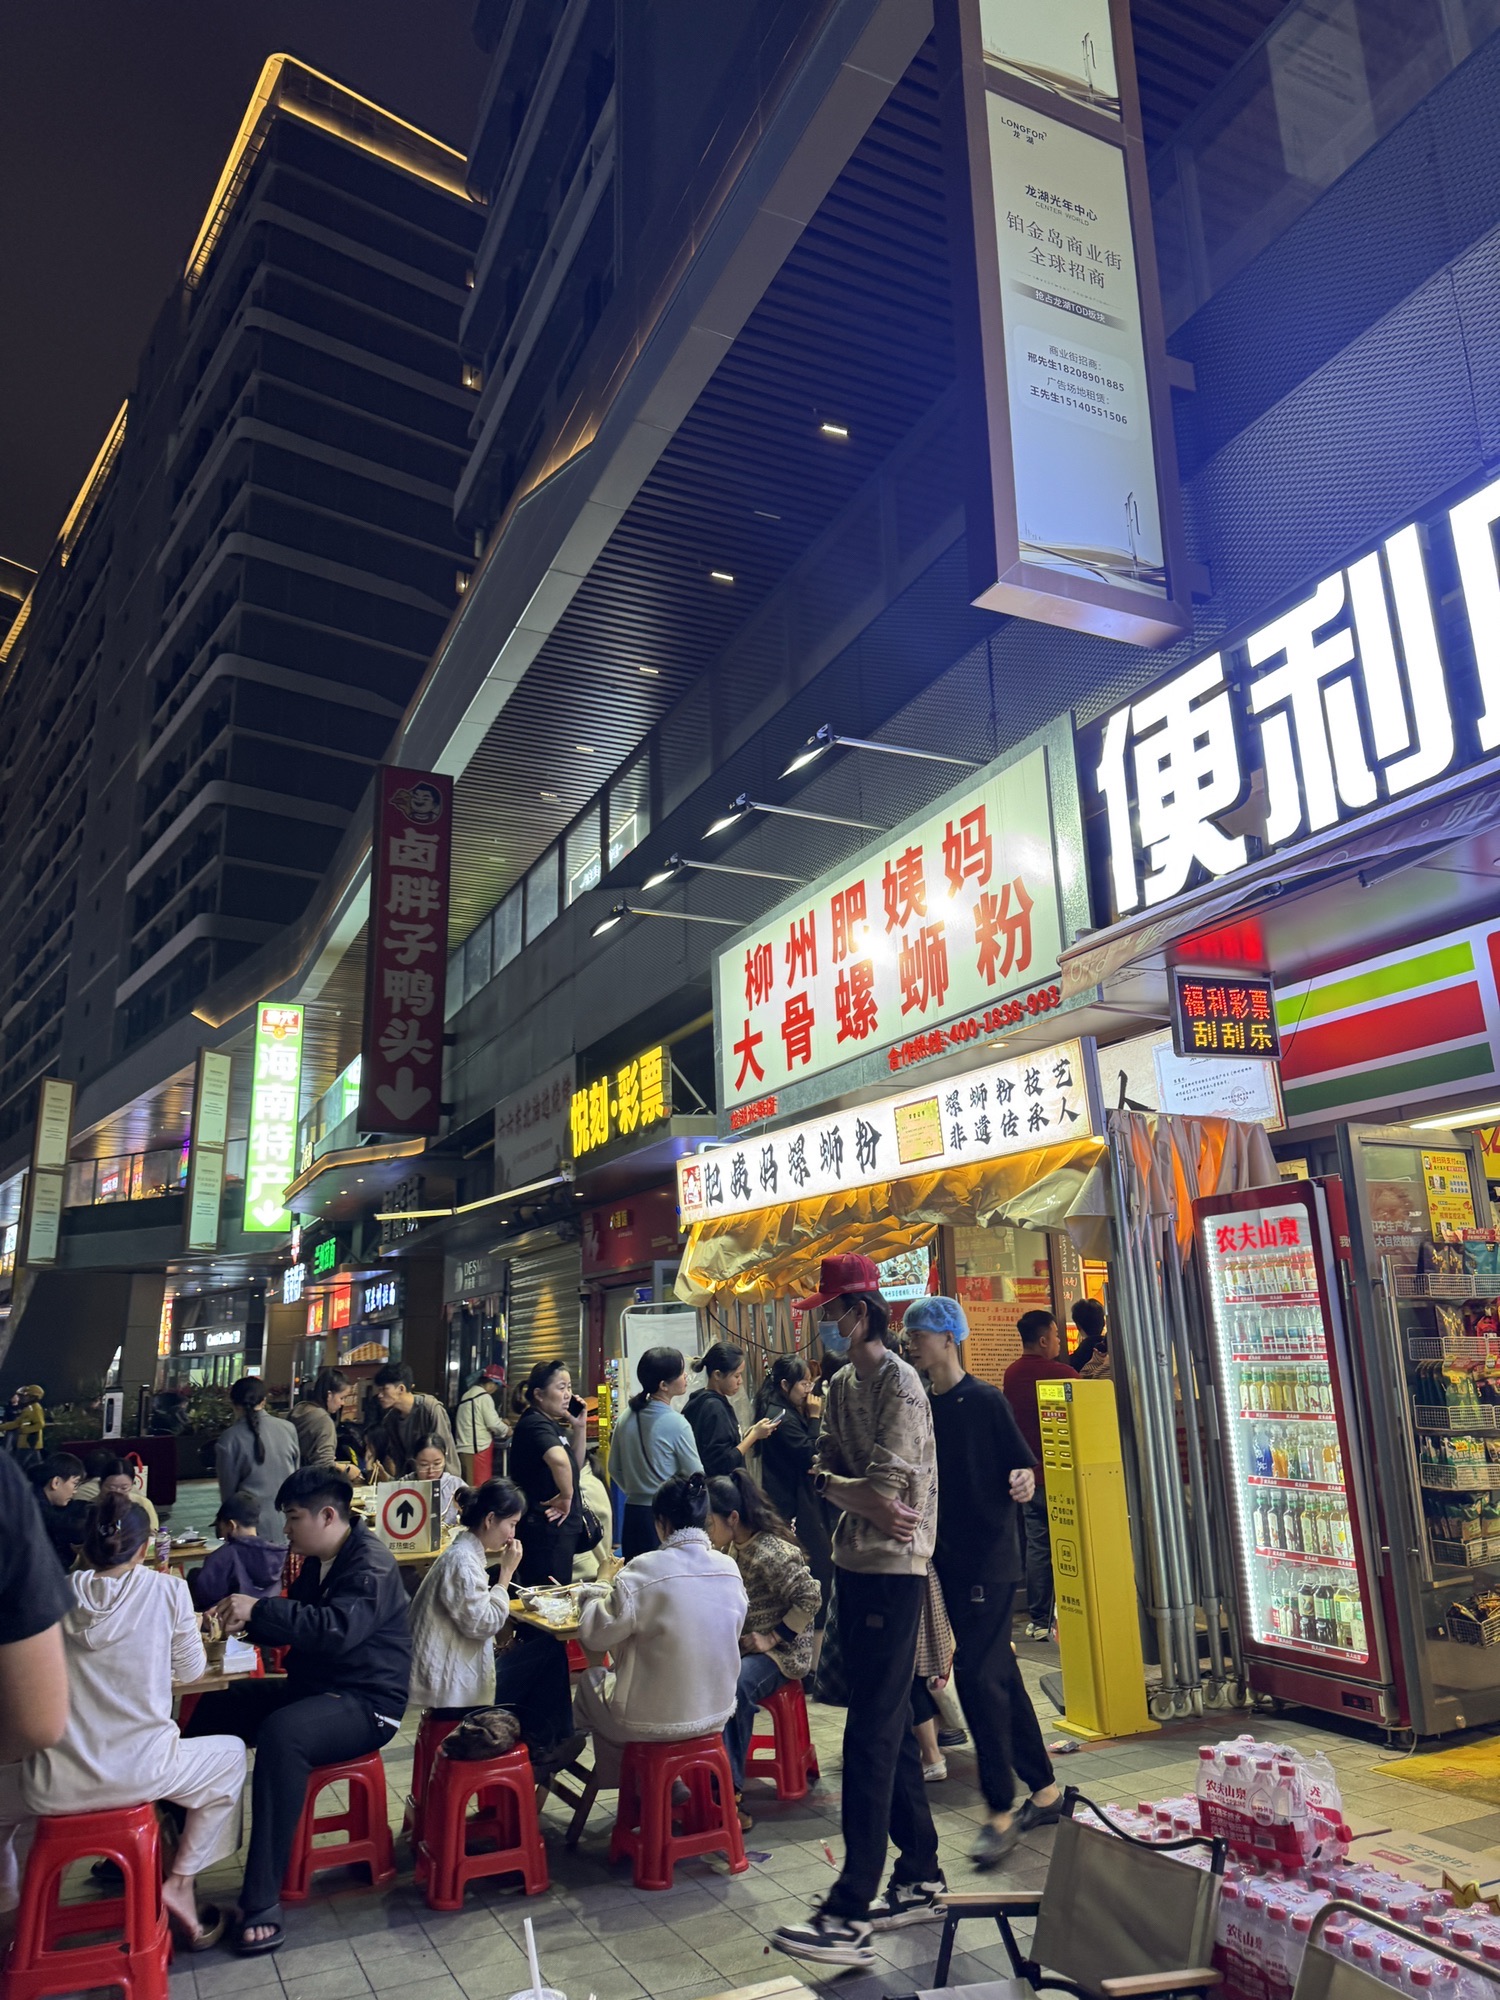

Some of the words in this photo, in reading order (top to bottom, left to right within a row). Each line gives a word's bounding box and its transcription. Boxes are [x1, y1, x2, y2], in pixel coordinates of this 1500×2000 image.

[1025, 184, 1097, 221] 龙湖光年中心
[1035, 201, 1062, 215] CENTER
[1065, 212, 1090, 226] WORLD
[1006, 211, 1122, 270] 铂金岛商业街
[1028, 246, 1105, 288] 全球招商
[1035, 290, 1106, 323] 抢占龙湖TOD板块
[1027, 352, 1125, 392] 邢先生18208901885
[1030, 385, 1128, 425] 王先生15140551506
[1096, 479, 1500, 913] 便利
[744, 803, 994, 1012] 柳州肥姨妈
[379, 828, 441, 1065] 卤胖子鸭头
[733, 876, 1035, 1092] 大骨螺蛳粉
[1184, 984, 1271, 1021] 福利彩票
[1193, 1021, 1273, 1050] 刮刮乐
[570, 1045, 664, 1158] 悦刻·彩票
[946, 1059, 1072, 1117] 螺蛳粉技艺
[248, 1043, 298, 1202] 海南特产
[950, 1097, 1080, 1150] 非遗传承人
[704, 1117, 882, 1207] 肥姨妈螺蛳粉
[1216, 1216, 1301, 1254] 农夫山泉
[1206, 1779, 1246, 1800] 农夫山泉
[1400, 1843, 1472, 1869] 东方树叶
